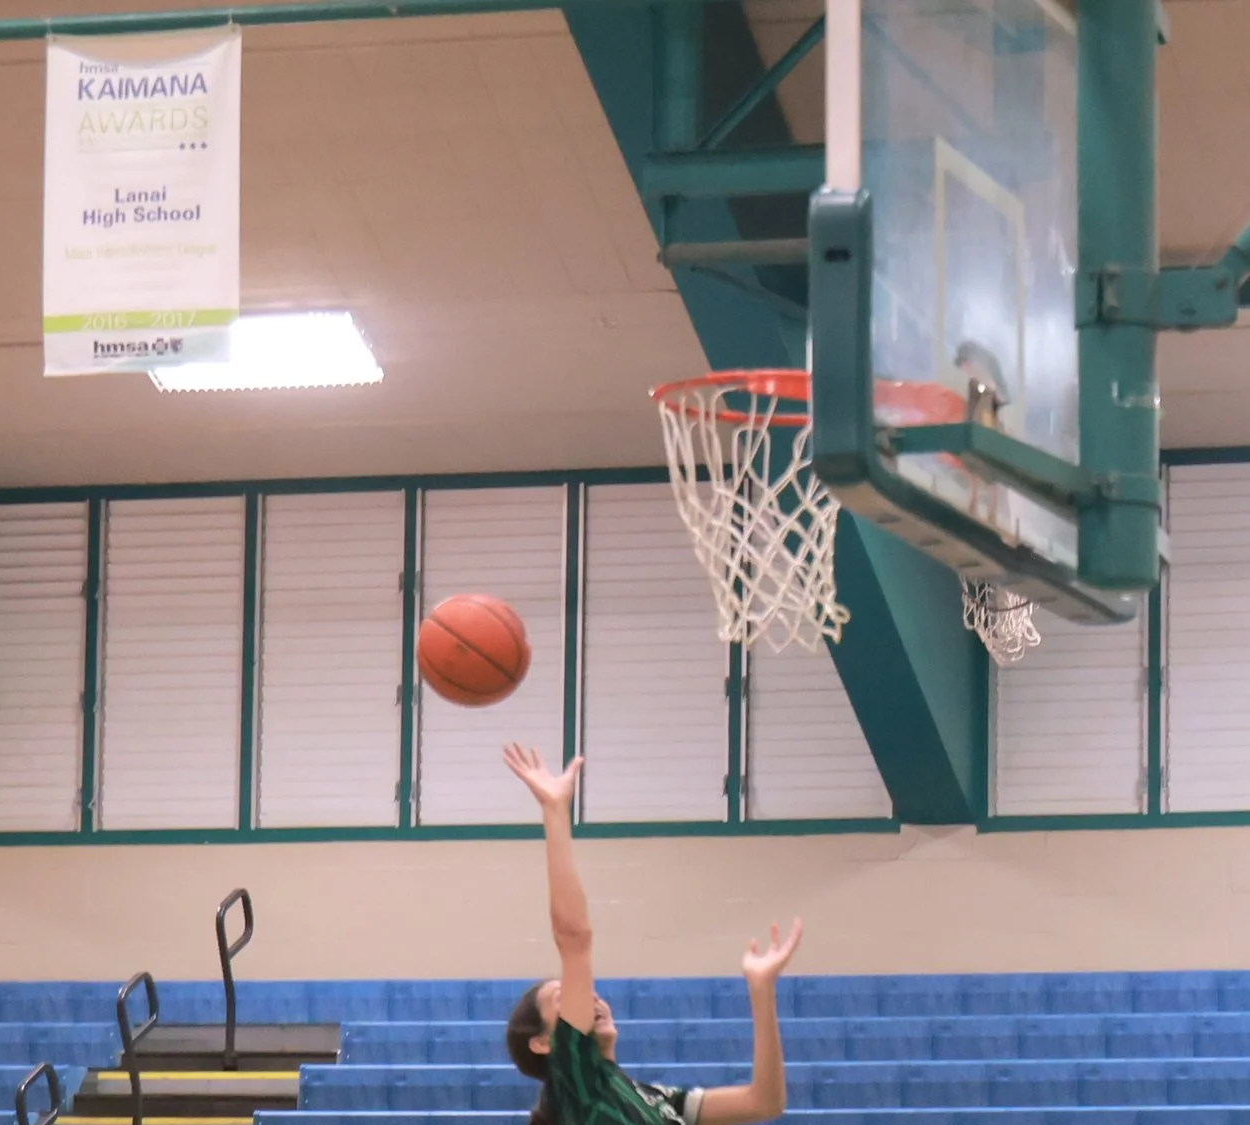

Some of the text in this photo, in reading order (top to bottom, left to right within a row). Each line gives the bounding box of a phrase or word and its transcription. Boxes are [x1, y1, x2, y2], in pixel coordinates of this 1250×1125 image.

[77, 72, 208, 101] KAIMANA
[79, 105, 209, 135] AWARDS
[114, 185, 167, 203] Lanai
[82, 204, 201, 228] High School
[151, 310, 197, 329] 2017
[94, 340, 149, 354] hmsa
